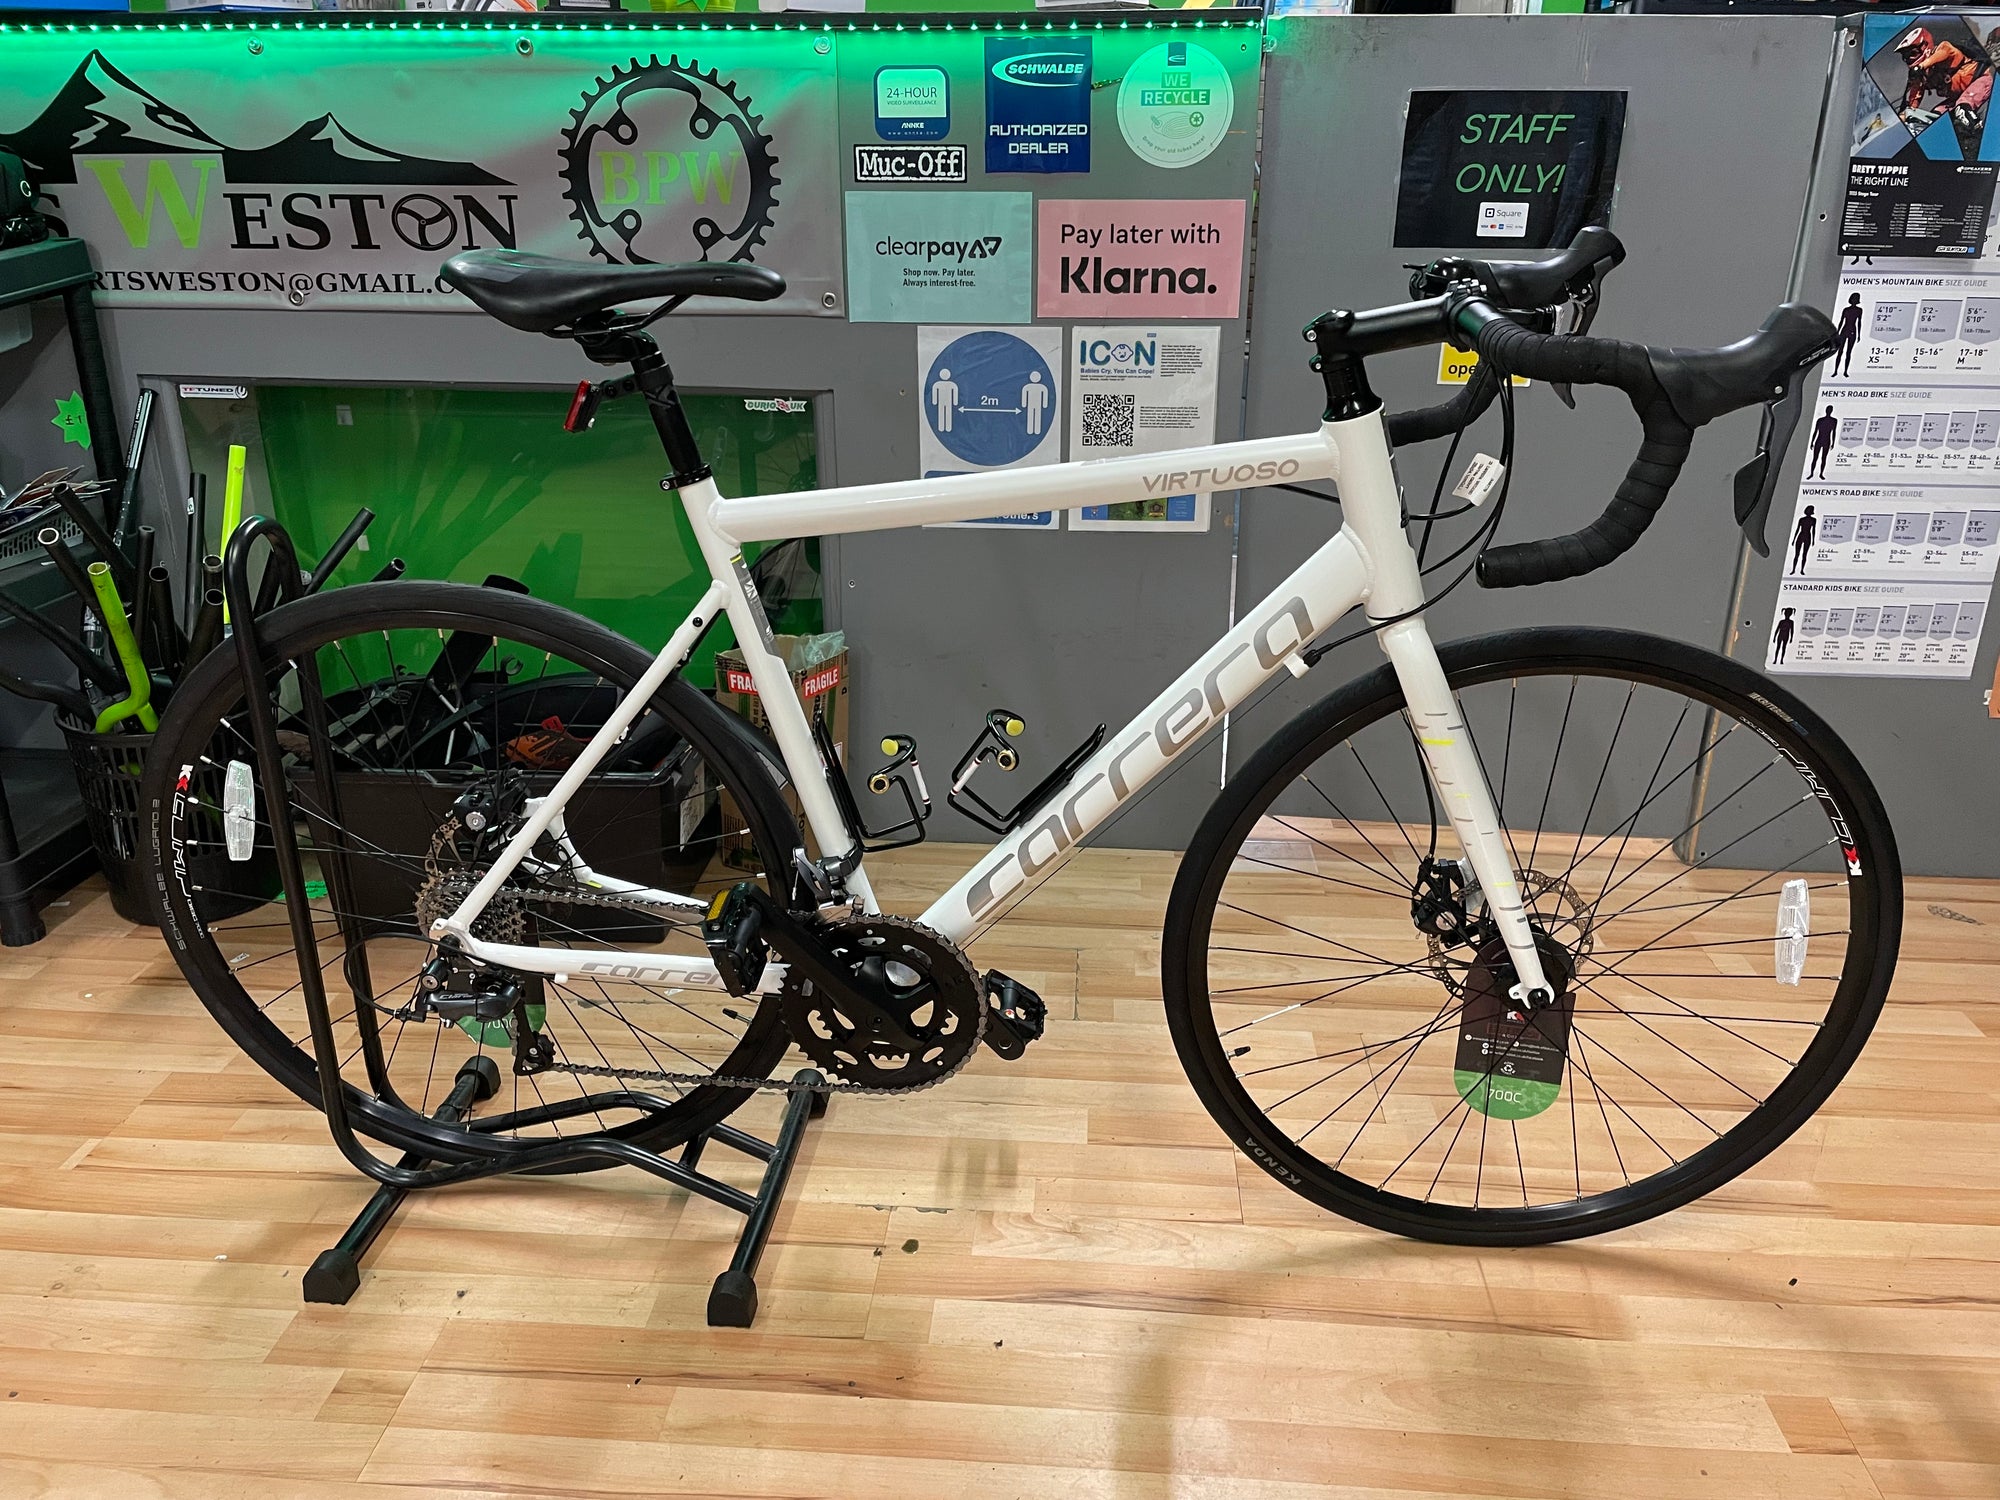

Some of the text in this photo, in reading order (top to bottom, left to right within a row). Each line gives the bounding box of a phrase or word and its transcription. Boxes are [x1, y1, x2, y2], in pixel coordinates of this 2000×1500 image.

[1008, 62, 1085, 77] SCHWALBE
[1164, 74, 1188, 87] WE
[886, 87, 938, 99] 24-HOUR
[1145, 90, 1207, 105] RECYCLE
[989, 124, 1088, 138] AUTHORIZED
[1459, 113, 1576, 144] STAFF
[1008, 141, 1069, 155] DEALER
[861, 151, 962, 177] Muc-Off
[1851, 164, 1909, 175] BRETT TIPPIE
[599, 149, 742, 205] BPW
[1455, 163, 1567, 193] ONLY!
[1850, 176, 1909, 187] THE RIGHT LINE
[1496, 209, 1522, 218] Square
[1060, 222, 1221, 248] Pay later with
[875, 235, 968, 263] clearpay
[902, 268, 976, 278] Shop now. Pay later.
[1060, 256, 1218, 295] Klarna.
[902, 279, 976, 289] Always interest-free.
[1843, 278, 1880, 286] WOMEN'S
[1881, 278, 1924, 286] MOUNTAIN
[1963, 279, 1988, 287] GUIDE
[1447, 362, 1477, 377] ope
[980, 395, 999, 406] 2m
[1821, 390, 1846, 398] MEN'S
[1847, 390, 1869, 398] ROAD
[1870, 390, 1889, 398] BIKE
[1908, 391, 1933, 399] GUIDE
[1142, 457, 1300, 494] VIRTUOSO
[1802, 488, 1838, 496] WOMEN'S
[1862, 489, 1881, 497] BIKE
[1783, 583, 1824, 592] STANDARD
[1824, 584, 1843, 592] KIDS
[805, 668, 839, 697] FRAGILE
[966, 596, 1317, 923] carrera
[152, 811, 163, 867] LUGANO
[156, 872, 187, 951] SCHWALBE
[1487, 1089, 1523, 1104] 700C
[1245, 1137, 1302, 1185] KENDA
